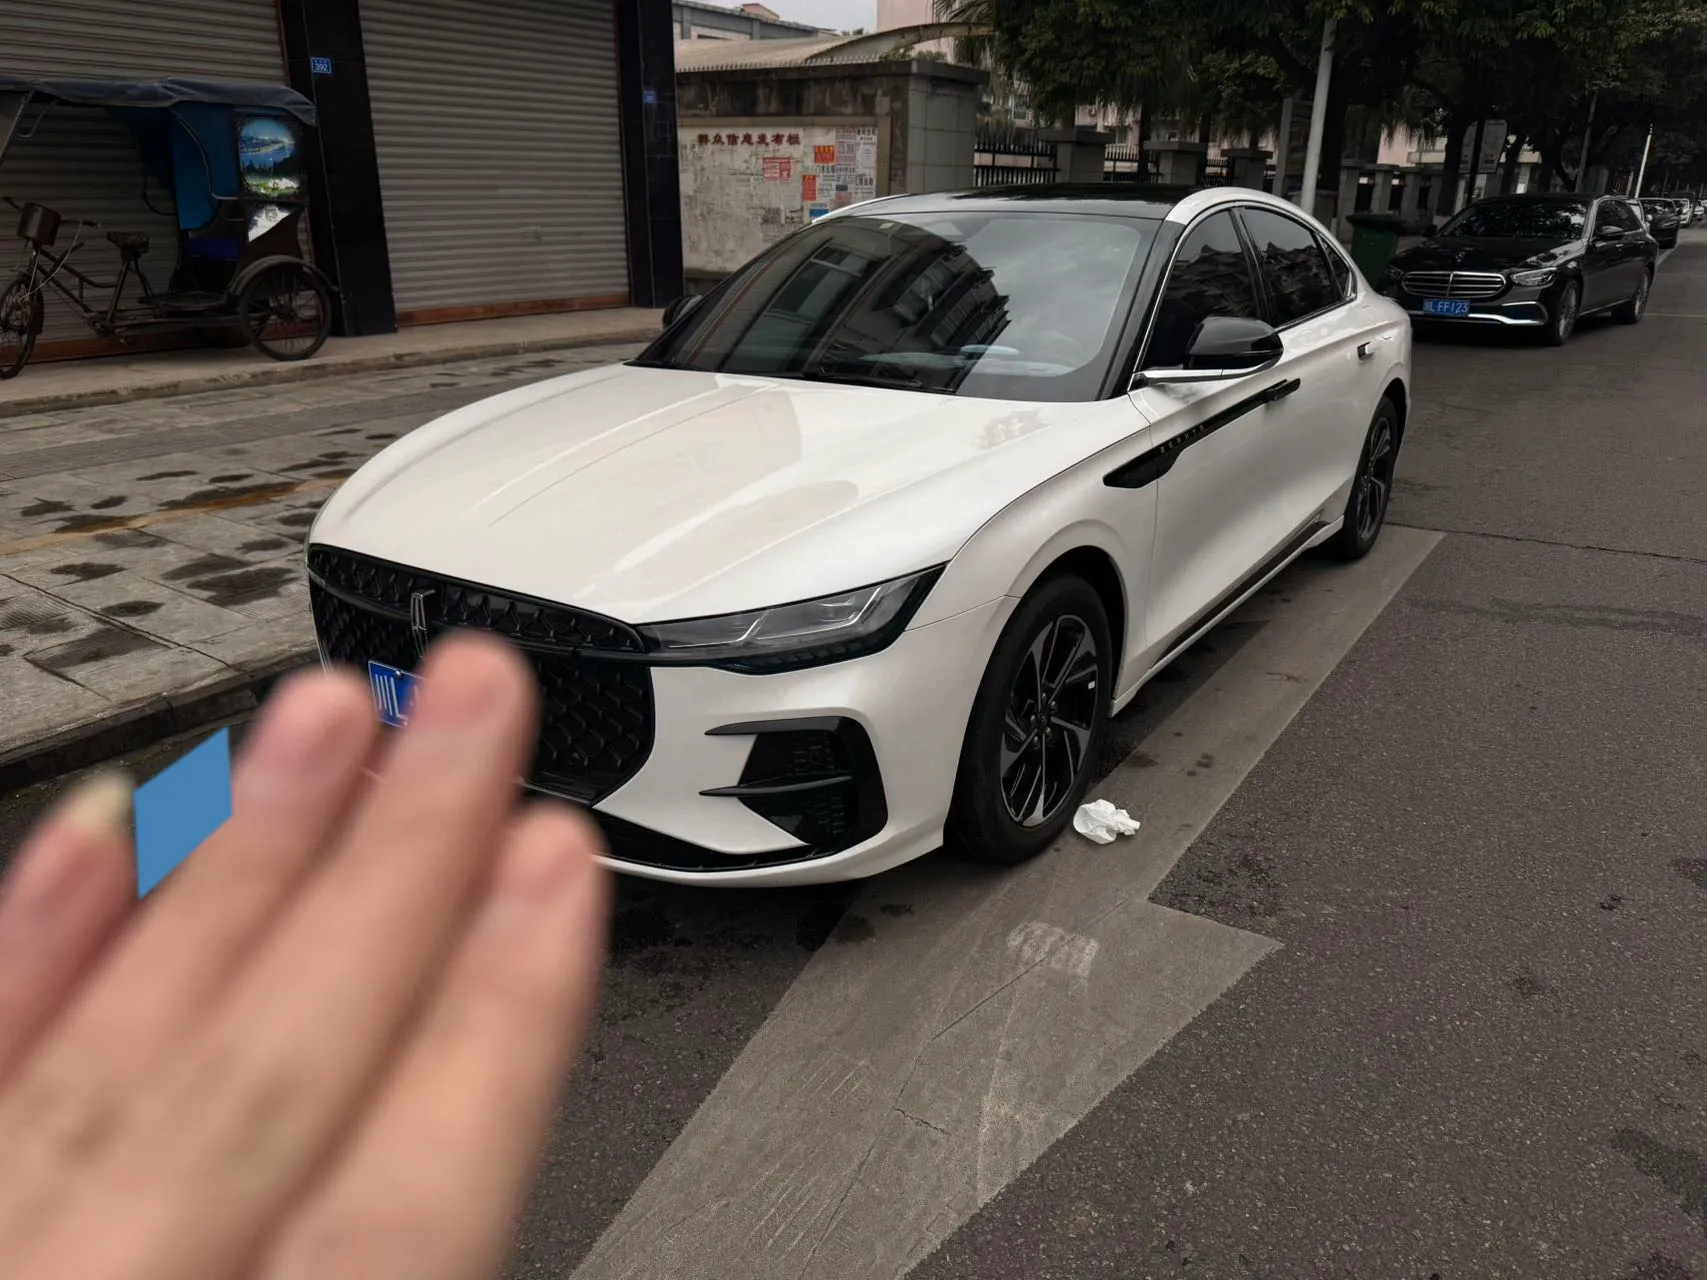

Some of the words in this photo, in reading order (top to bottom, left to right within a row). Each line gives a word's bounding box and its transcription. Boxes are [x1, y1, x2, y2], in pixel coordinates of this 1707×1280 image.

[697, 132, 801, 146] 群众信息发布栏
